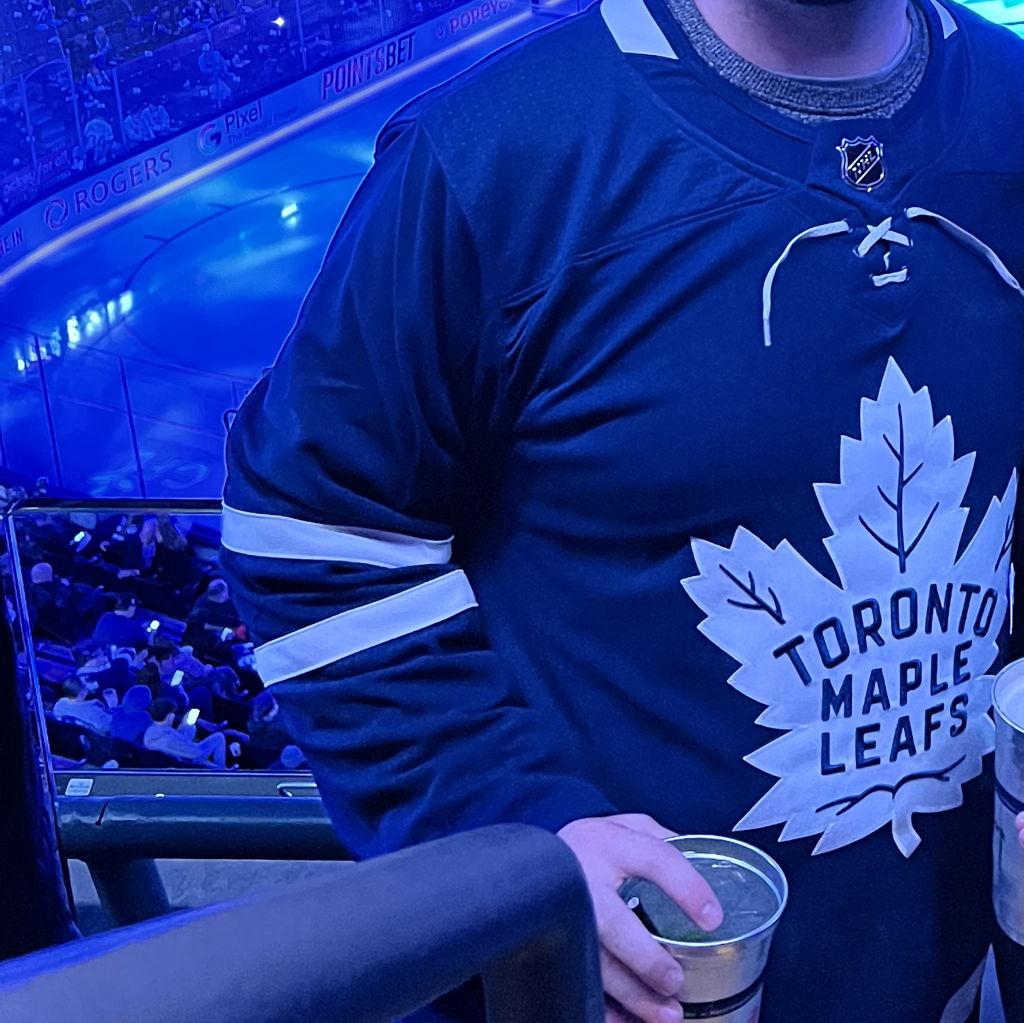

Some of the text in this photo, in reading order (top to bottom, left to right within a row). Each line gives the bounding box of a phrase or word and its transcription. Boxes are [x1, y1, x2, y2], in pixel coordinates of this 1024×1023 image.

[321, 32, 416, 102] POINTSBET
[224, 99, 263, 134] Pixel
[74, 149, 174, 214] ROGERS
[773, 583, 998, 687] TORONTO
[821, 640, 975, 723] MAPLE
[820, 693, 970, 776] LEAFS
